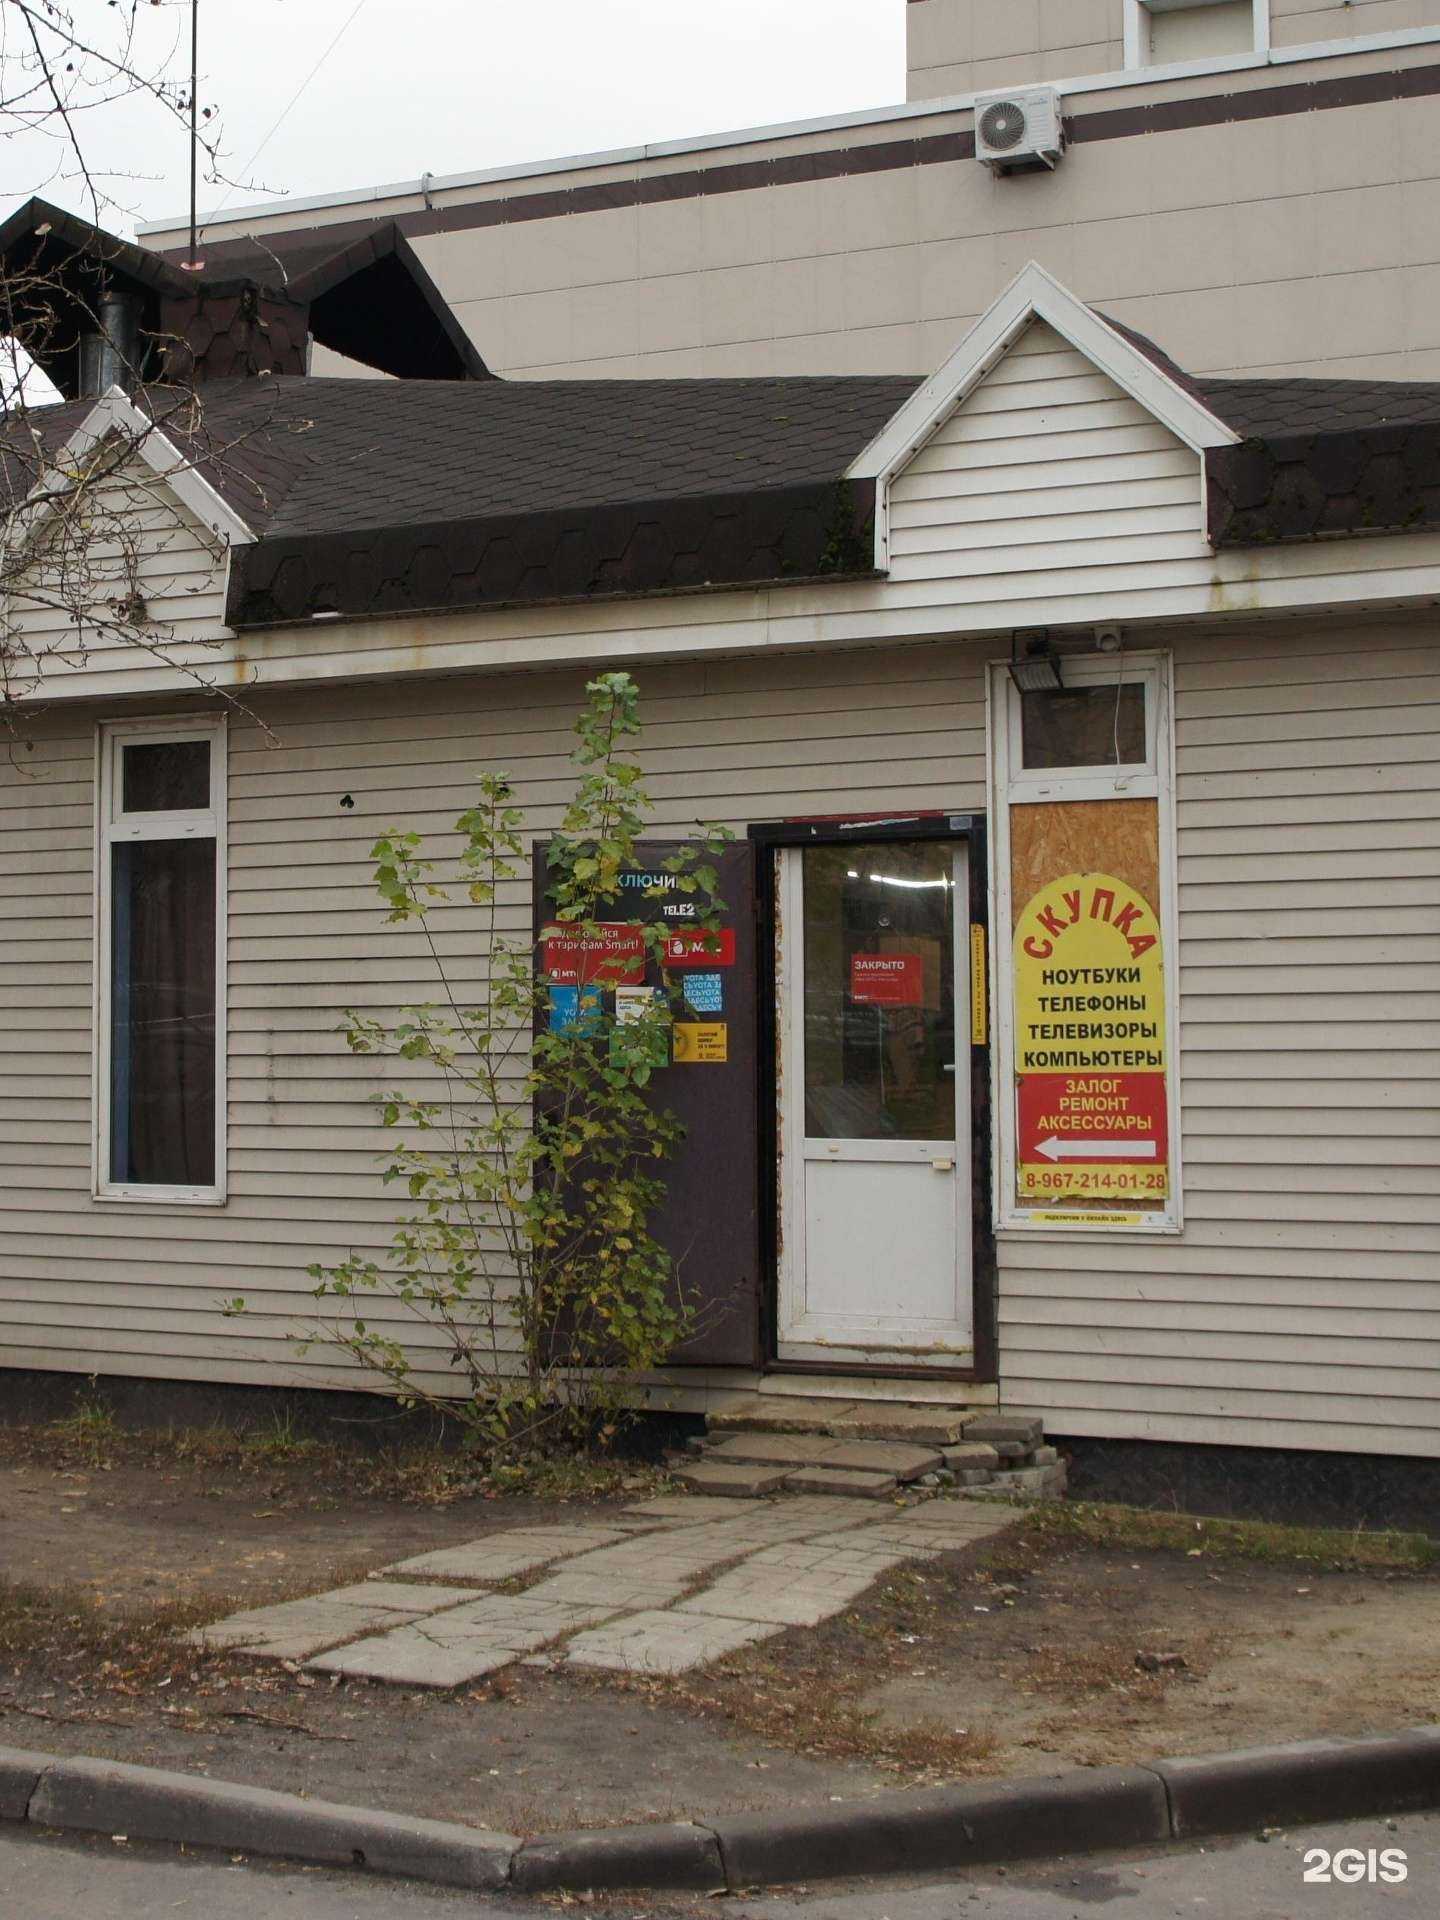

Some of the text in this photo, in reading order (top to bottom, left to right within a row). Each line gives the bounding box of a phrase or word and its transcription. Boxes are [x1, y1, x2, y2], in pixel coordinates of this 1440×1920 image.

[663, 902, 695, 916] TELE2
[1023, 887, 1157, 959] СКУПКА
[854, 960, 905, 970] ЗАКРЫТО
[1042, 968, 1141, 985] НОУТБУКИ
[1038, 995, 1146, 1012] ТЕЛЕФОНЫ
[1028, 1023, 1157, 1040] ТЕЛЕВИЗОРЫ
[1024, 1050, 1162, 1067] КОМПЬЮТЕРЫ
[1065, 1079, 1122, 1094] ЗАЛОГ
[1059, 1097, 1130, 1111] РЕМОНТ
[1037, 1115, 1152, 1130] АКСЕССУАРЫ
[1026, 1172, 1165, 1189] 8-967-214-01-28
